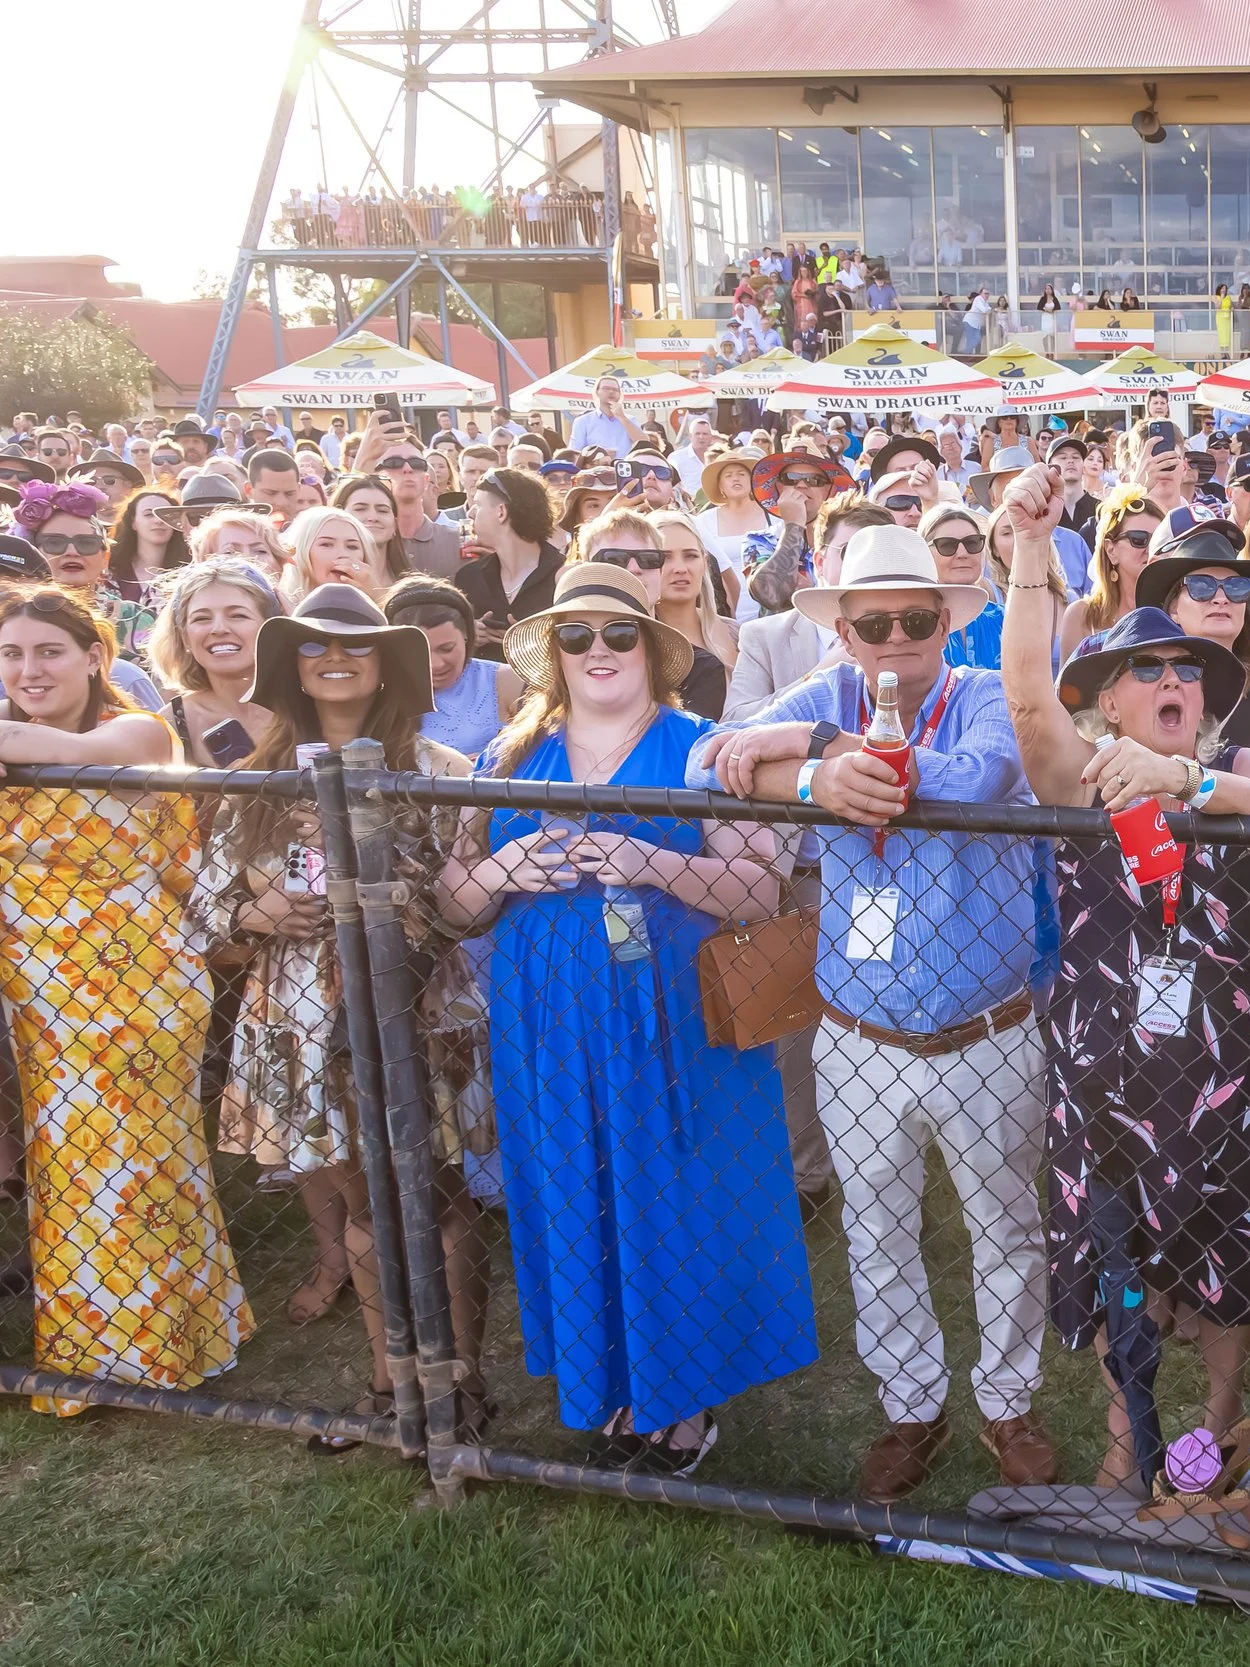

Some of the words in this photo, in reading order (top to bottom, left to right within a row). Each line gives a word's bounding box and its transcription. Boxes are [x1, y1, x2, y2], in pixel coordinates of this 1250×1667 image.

[1100, 330, 1128, 338] SWAN
[661, 339, 690, 348] SWAN
[313, 370, 400, 380] SWAN
[844, 366, 928, 380] SWAN
[584, 378, 651, 388] SAN
[1120, 375, 1174, 384] SWAN
[721, 387, 754, 395] SWAN
[282, 394, 336, 404] SWAN
[339, 393, 427, 404] DRAHT
[817, 397, 868, 409] SWAN
[875, 394, 961, 409] DRAUGHT
[568, 400, 596, 409] SWA
[624, 400, 681, 410] RAUGHT
[1014, 401, 1067, 414] RAUGHT
[1146, 1020, 1177, 1029] ACCESS
